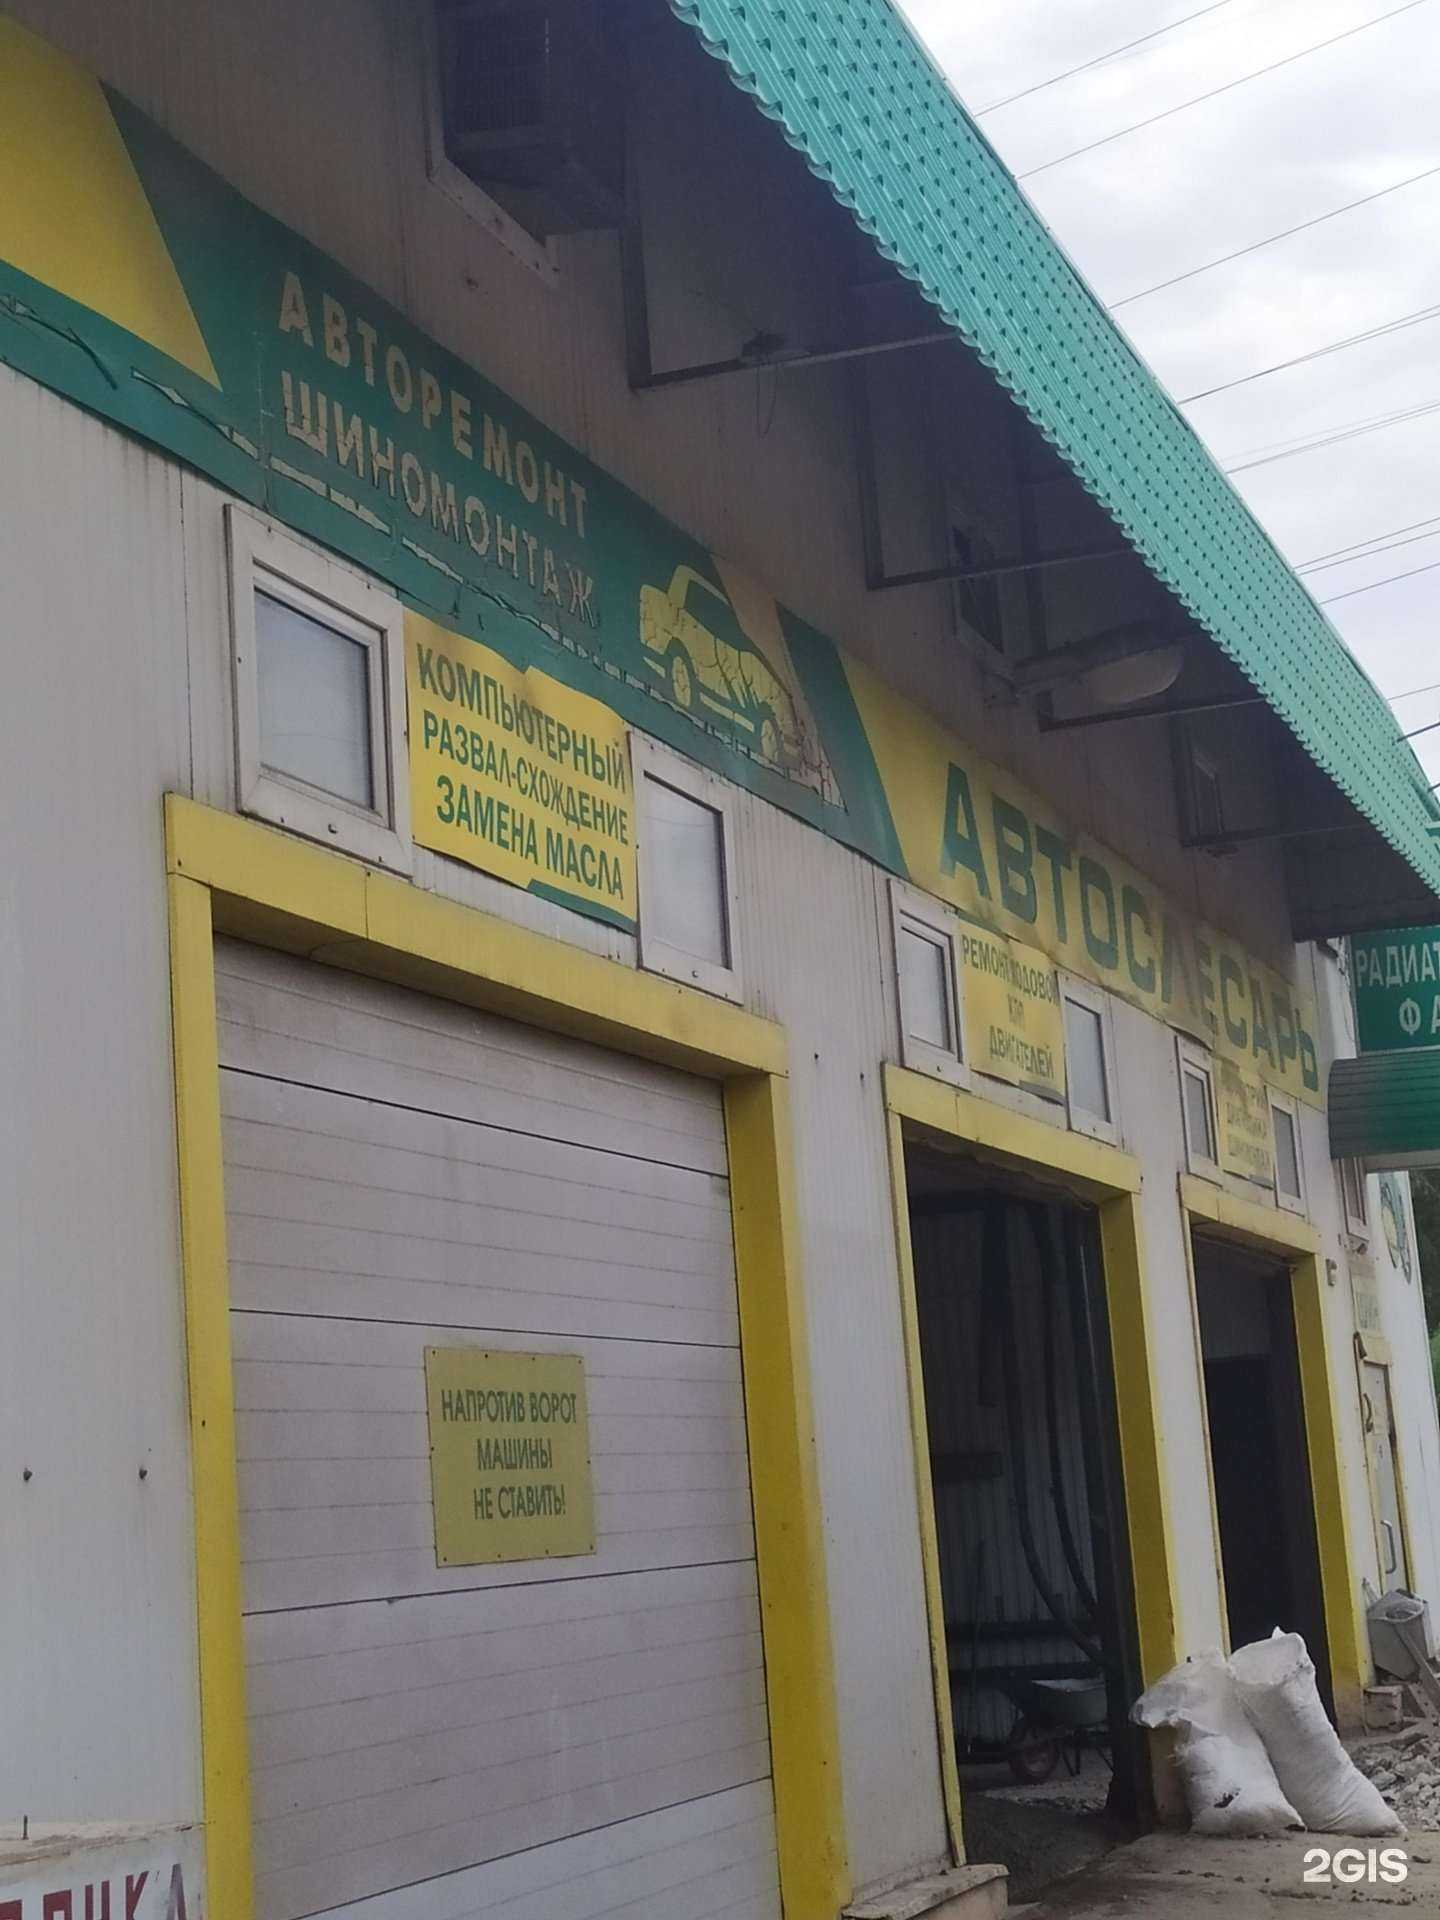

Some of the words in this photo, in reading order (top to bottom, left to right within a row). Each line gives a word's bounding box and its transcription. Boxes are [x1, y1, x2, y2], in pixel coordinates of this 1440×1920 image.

[279, 271, 587, 538] АВТОРЕМОНТ
[281, 370, 596, 628] ШИНОМОНТАЖ
[416, 643, 626, 794] КОМПЬЮТЕРНЫЙ
[423, 709, 629, 846] РАЗВАЛ-СХОЖДЕНИЕ
[436, 775, 539, 866] ЗАМЕНА
[546, 827, 624, 901] МАСЛА
[939, 760, 1319, 1092] АВТОСЛЕСАРЬ
[441, 1389, 525, 1422] НАПРОТИВ
[529, 1392, 577, 1423] ВОРОТ
[477, 1438, 552, 1471] МАШИНЫ
[473, 1487, 494, 1520] НЕ
[498, 1484, 567, 1519] СТАВИТЬ!
